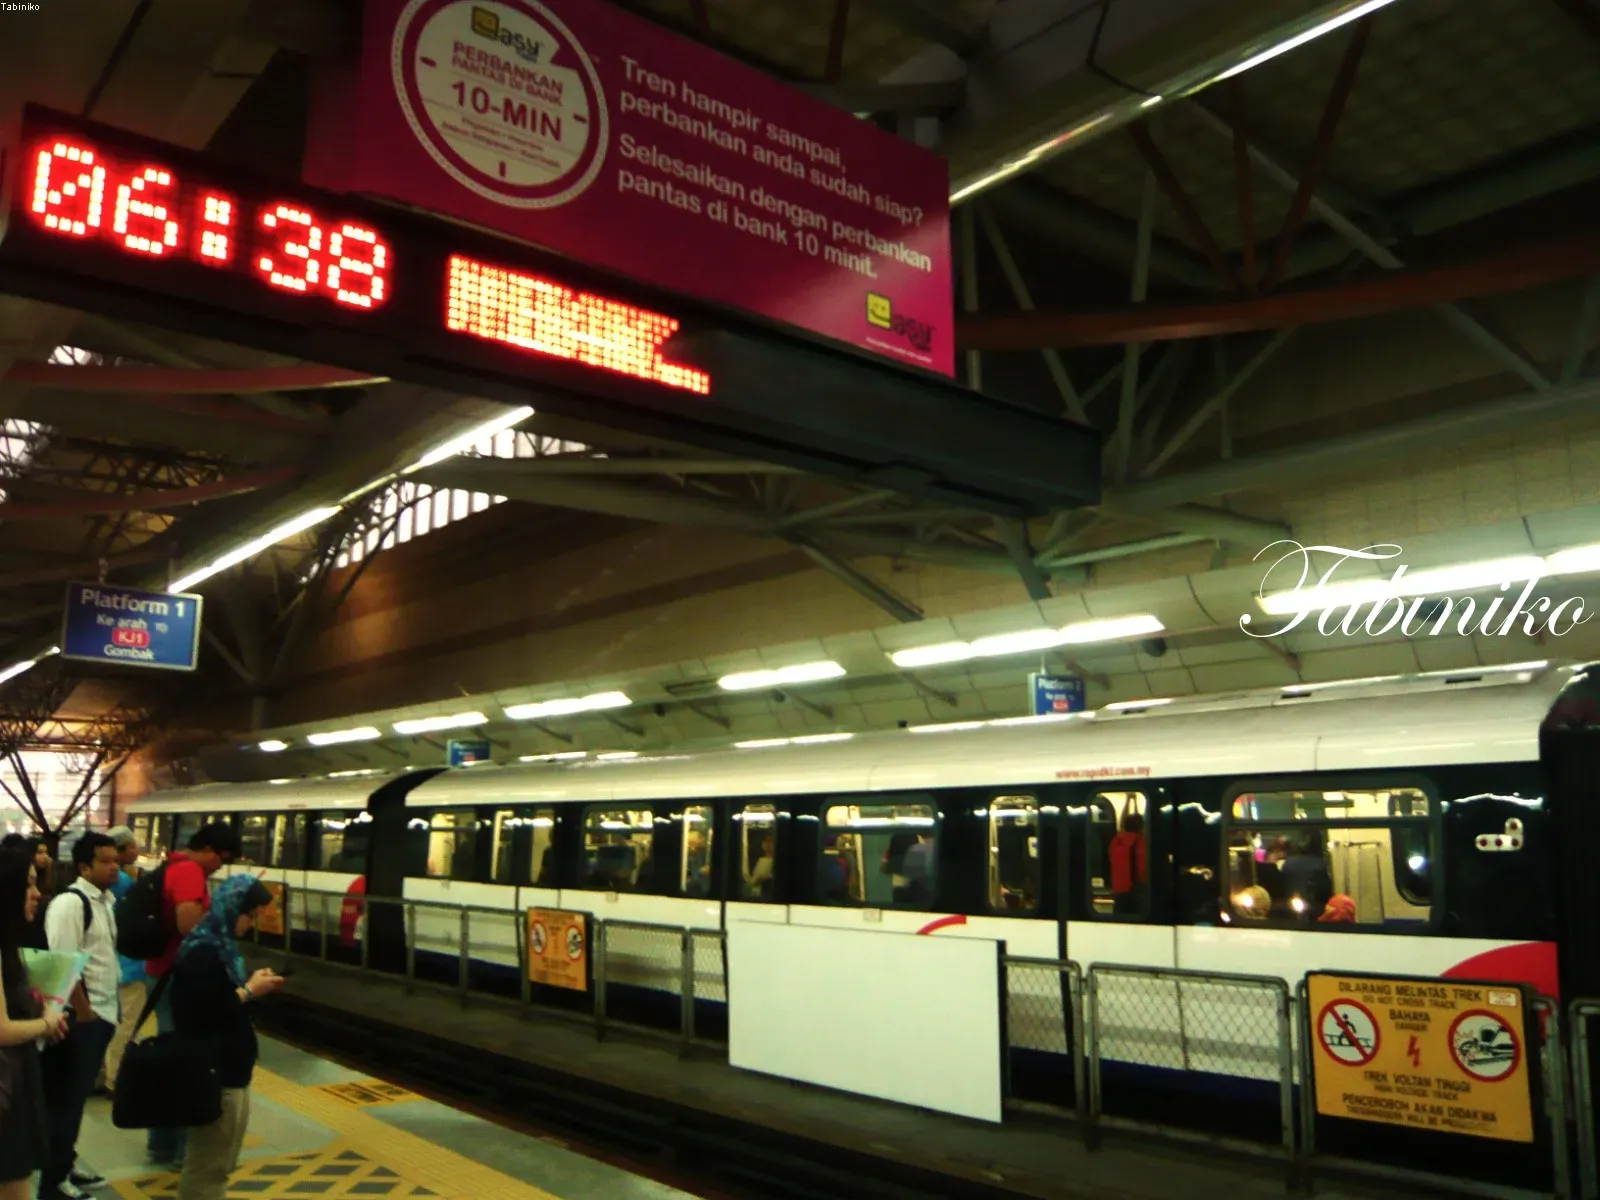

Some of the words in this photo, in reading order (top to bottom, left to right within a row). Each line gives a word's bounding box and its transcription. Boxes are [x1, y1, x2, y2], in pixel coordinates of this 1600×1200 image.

[453, 40, 563, 94] PERBANKAN
[452, 80, 562, 142] 10-MIN
[620, 55, 676, 98] Tren
[682, 80, 762, 132] hampir
[766, 122, 846, 174] sampai,
[620, 90, 747, 155] perbankan
[752, 144, 805, 180] anda
[810, 167, 870, 206] sudah
[875, 194, 923, 227] siap?
[619, 133, 745, 200] Selesaikan
[750, 186, 828, 232] dengan
[832, 221, 932, 273] perbankan
[32, 142, 387, 308] 06:38
[618, 168, 701, 214] pantas
[707, 199, 728, 223] di
[734, 205, 788, 246] bank
[794, 230, 819, 257] 10
[824, 244, 878, 279] minit.
[81, 588, 169, 617] Platform
[175, 600, 185, 618] 1
[97, 613, 115, 626] Ke
[117, 617, 148, 630] arah
[104, 643, 154, 660] Gombak
[118, 632, 144, 645] KJ1
[1338, 981, 1391, 996] DILARANG
[1395, 985, 1447, 999] MELINTAS
[1452, 989, 1482, 1001] TREK
[1388, 1008, 1431, 1022] BAHAYA
[1364, 1070, 1388, 1082] TREK
[1393, 1074, 1431, 1087] VOLTAN
[1435, 1078, 1472, 1093] TINGGI
[1342, 1092, 1410, 1111] PENCEROBOH
[1414, 1102, 1444, 1115] AKAN
[1447, 1106, 1498, 1122] DIDAKWA
